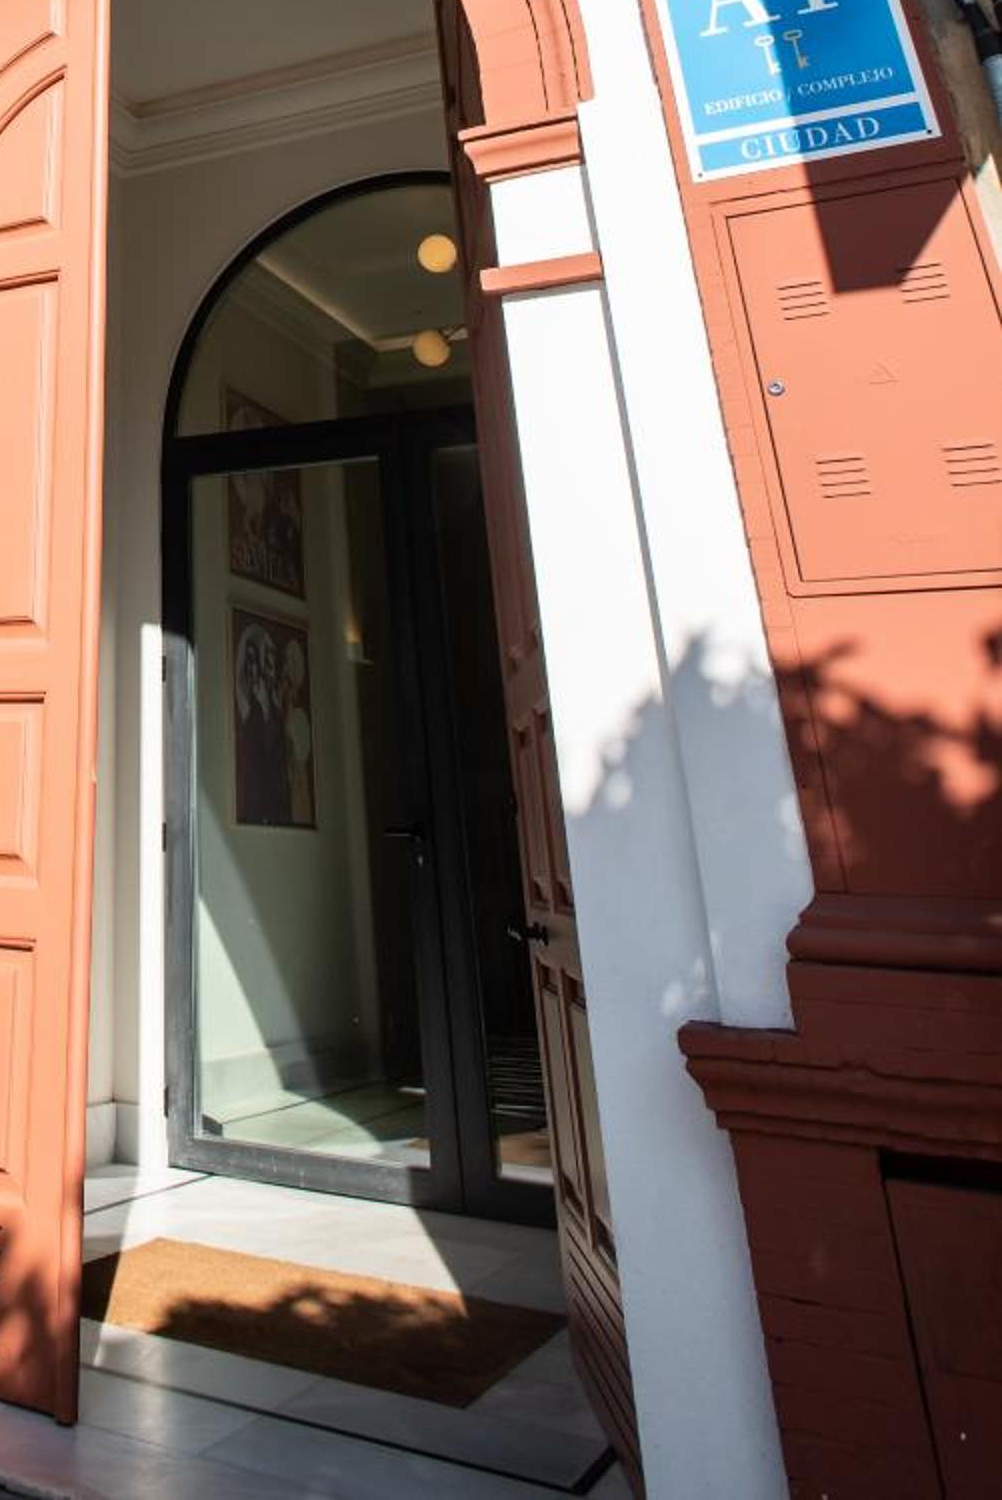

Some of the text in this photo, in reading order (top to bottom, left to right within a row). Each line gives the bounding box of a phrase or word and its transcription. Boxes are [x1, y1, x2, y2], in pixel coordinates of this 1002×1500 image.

[703, 88, 783, 117] EDIFICIO
[797, 67, 894, 97] COMPLEJO
[741, 116, 880, 160] CIUDAD
